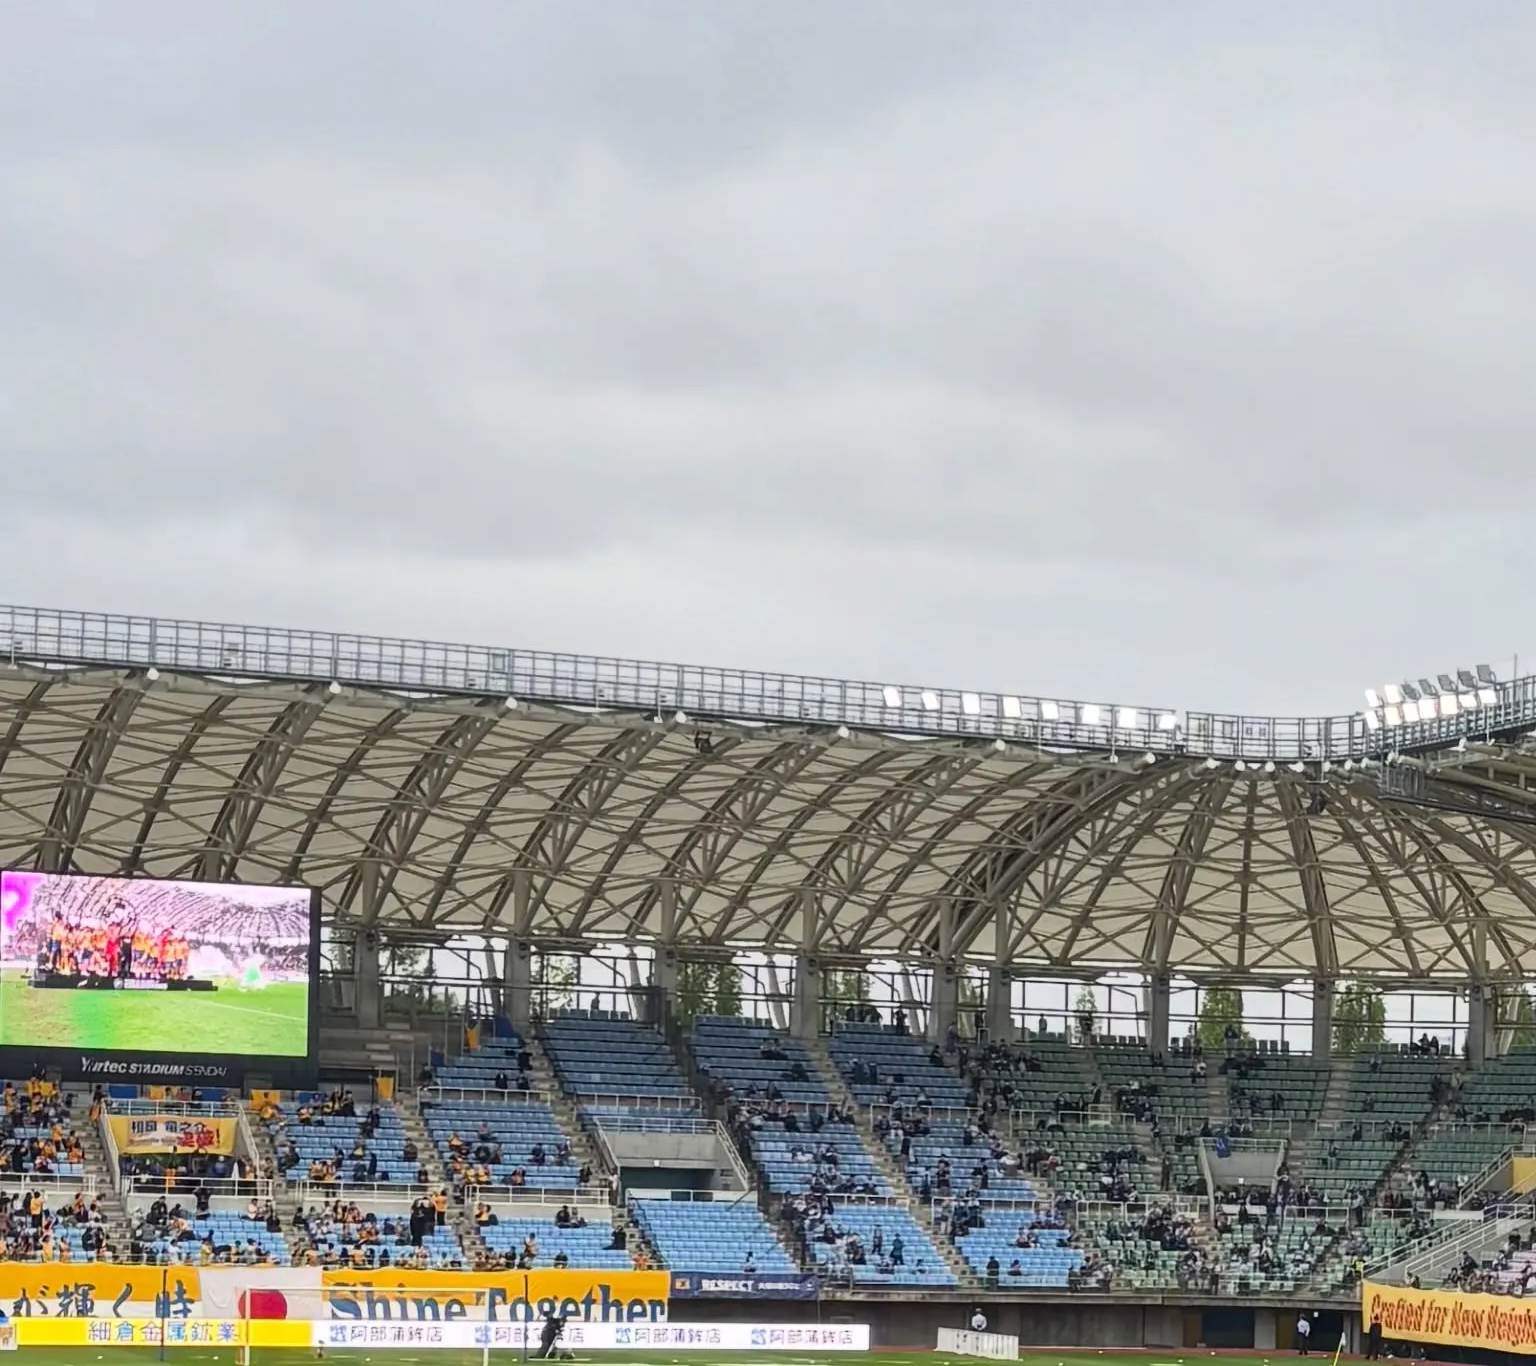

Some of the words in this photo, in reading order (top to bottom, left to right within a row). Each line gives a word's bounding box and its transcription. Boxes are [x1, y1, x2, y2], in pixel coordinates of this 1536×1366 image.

[128, 1062, 185, 1075] STADIUM
[328, 1281, 468, 1322] Shine
[88, 1321, 241, 1342] 細倉金属鉱業
